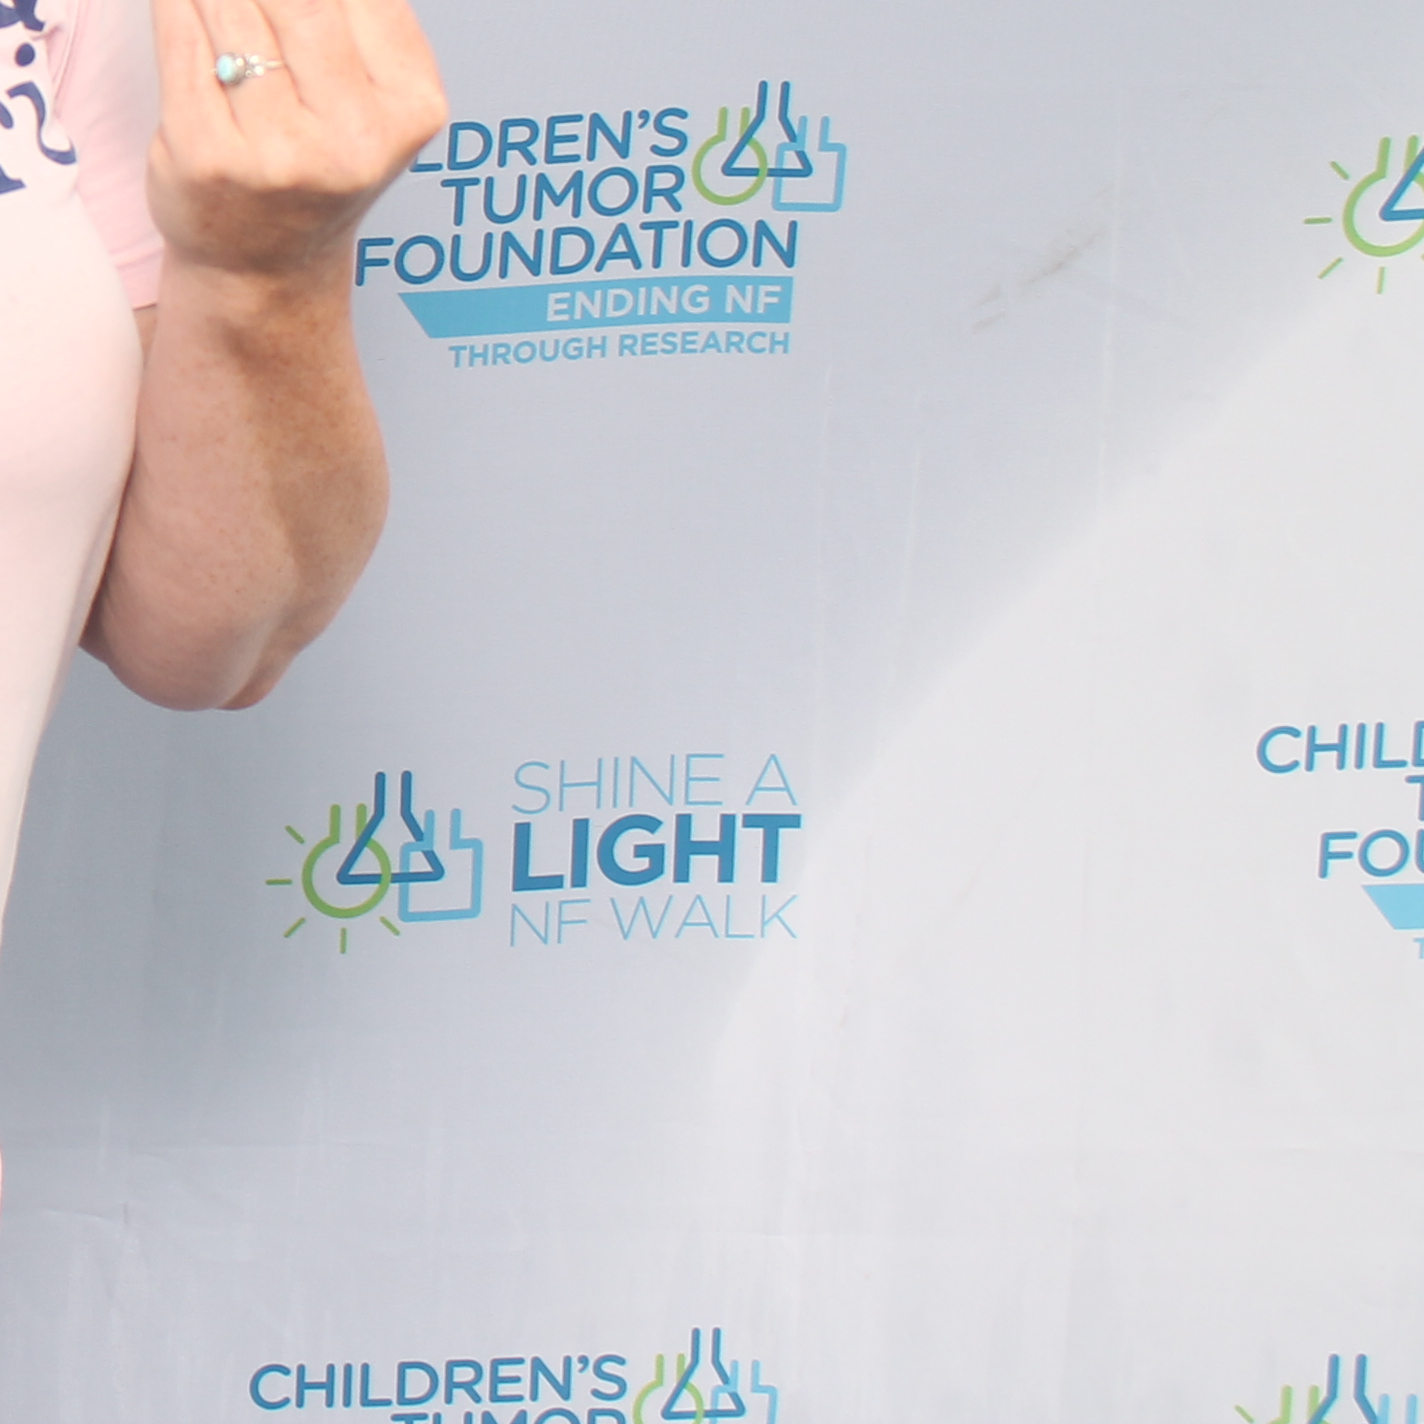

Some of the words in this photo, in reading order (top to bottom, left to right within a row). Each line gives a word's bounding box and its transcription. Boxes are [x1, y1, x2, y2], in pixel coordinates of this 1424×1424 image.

[441, 164, 685, 226] TUMOR
[355, 218, 797, 287] FOUNDATION
[546, 285, 709, 322] ENDING
[725, 285, 782, 314] NF
[449, 335, 607, 368] THROUGH
[618, 331, 790, 358] RESEARCH
[512, 753, 724, 814] SHINE
[745, 753, 798, 806] A
[512, 813, 802, 891] LIGHT
[510, 899, 591, 947] NF
[610, 894, 798, 940] WALK
[249, 1355, 627, 1410] CHILDREN'S
